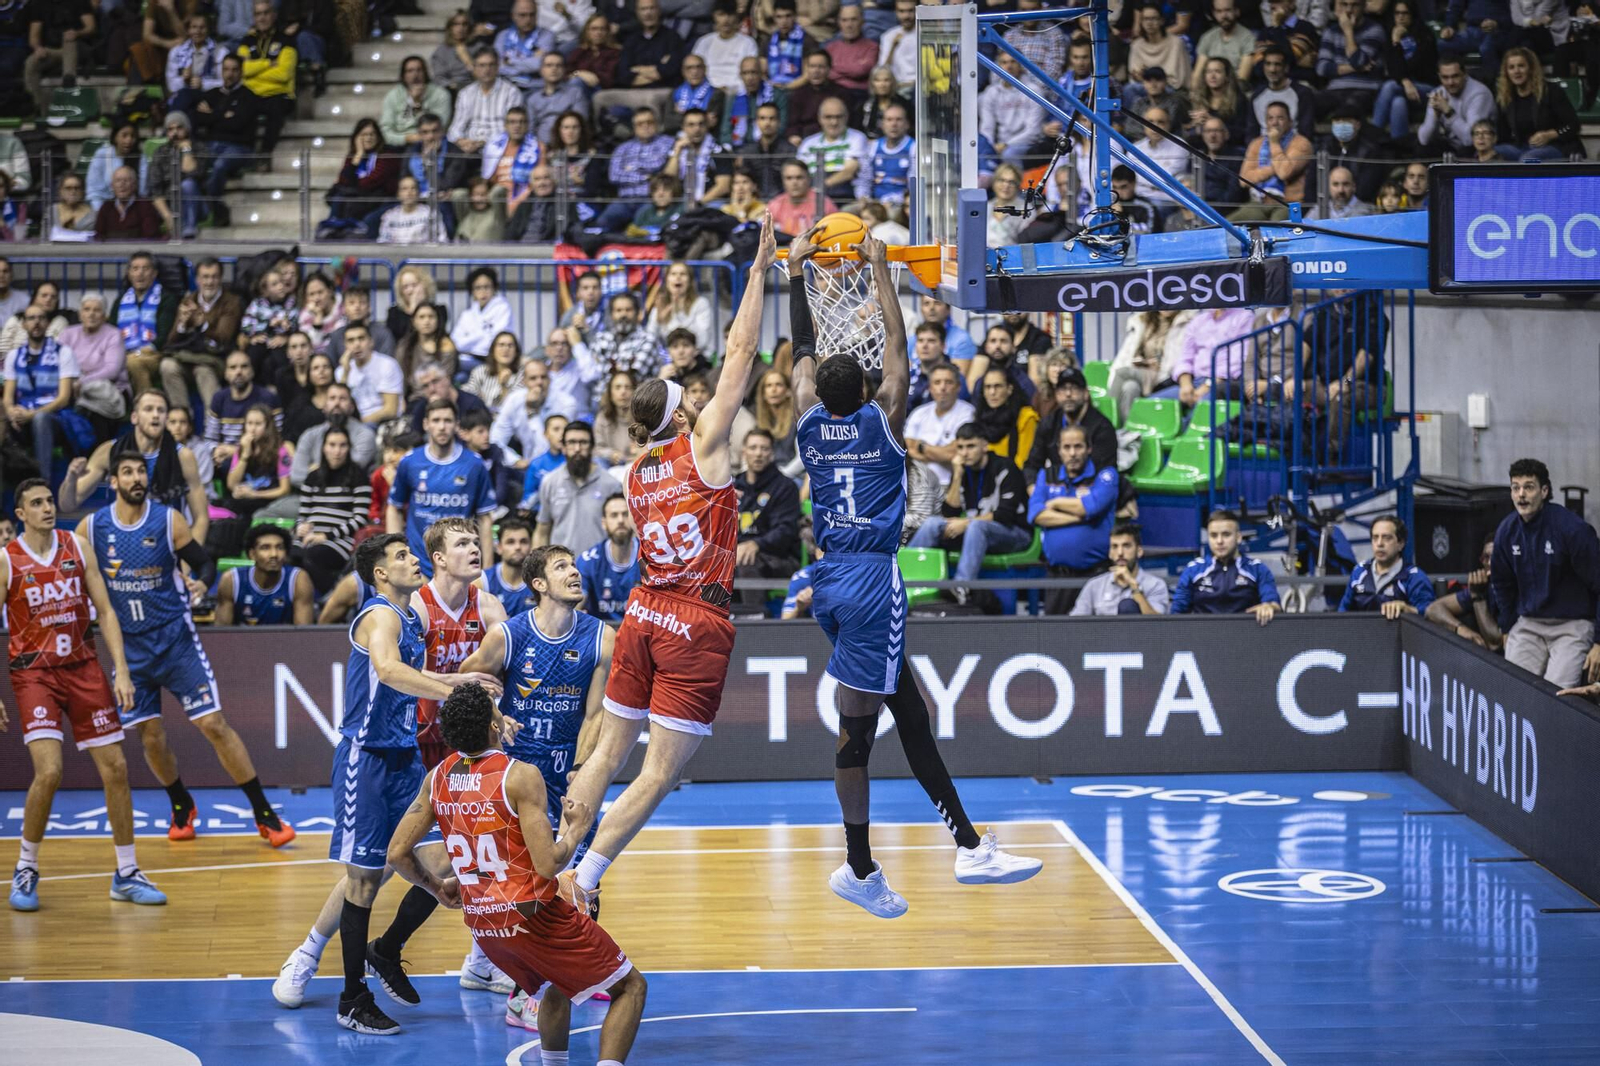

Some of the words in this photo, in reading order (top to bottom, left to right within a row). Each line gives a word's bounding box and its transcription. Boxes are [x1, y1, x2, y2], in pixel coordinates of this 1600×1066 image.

[1057, 269, 1246, 312] endesa
[820, 424, 859, 440] NZOSA
[825, 451, 858, 460] recoletas
[860, 449, 880, 459] salud
[641, 460, 674, 484] GOLDEN
[414, 491, 469, 507] BURGOS
[833, 467, 856, 517] 3
[642, 512, 705, 564] 33
[24, 576, 81, 608] BAXI
[40, 611, 78, 628] MANRESA
[128, 599, 145, 621] 11
[625, 599, 692, 641] Aquaflix
[56, 633, 72, 657] 8
[93, 716, 110, 728] ETL
[529, 716, 554, 740] 27
[1441, 673, 1538, 814] HYBRID
[448, 773, 482, 792] BROOKS
[436, 801, 496, 816] inmoovs
[446, 834, 509, 886] 24
